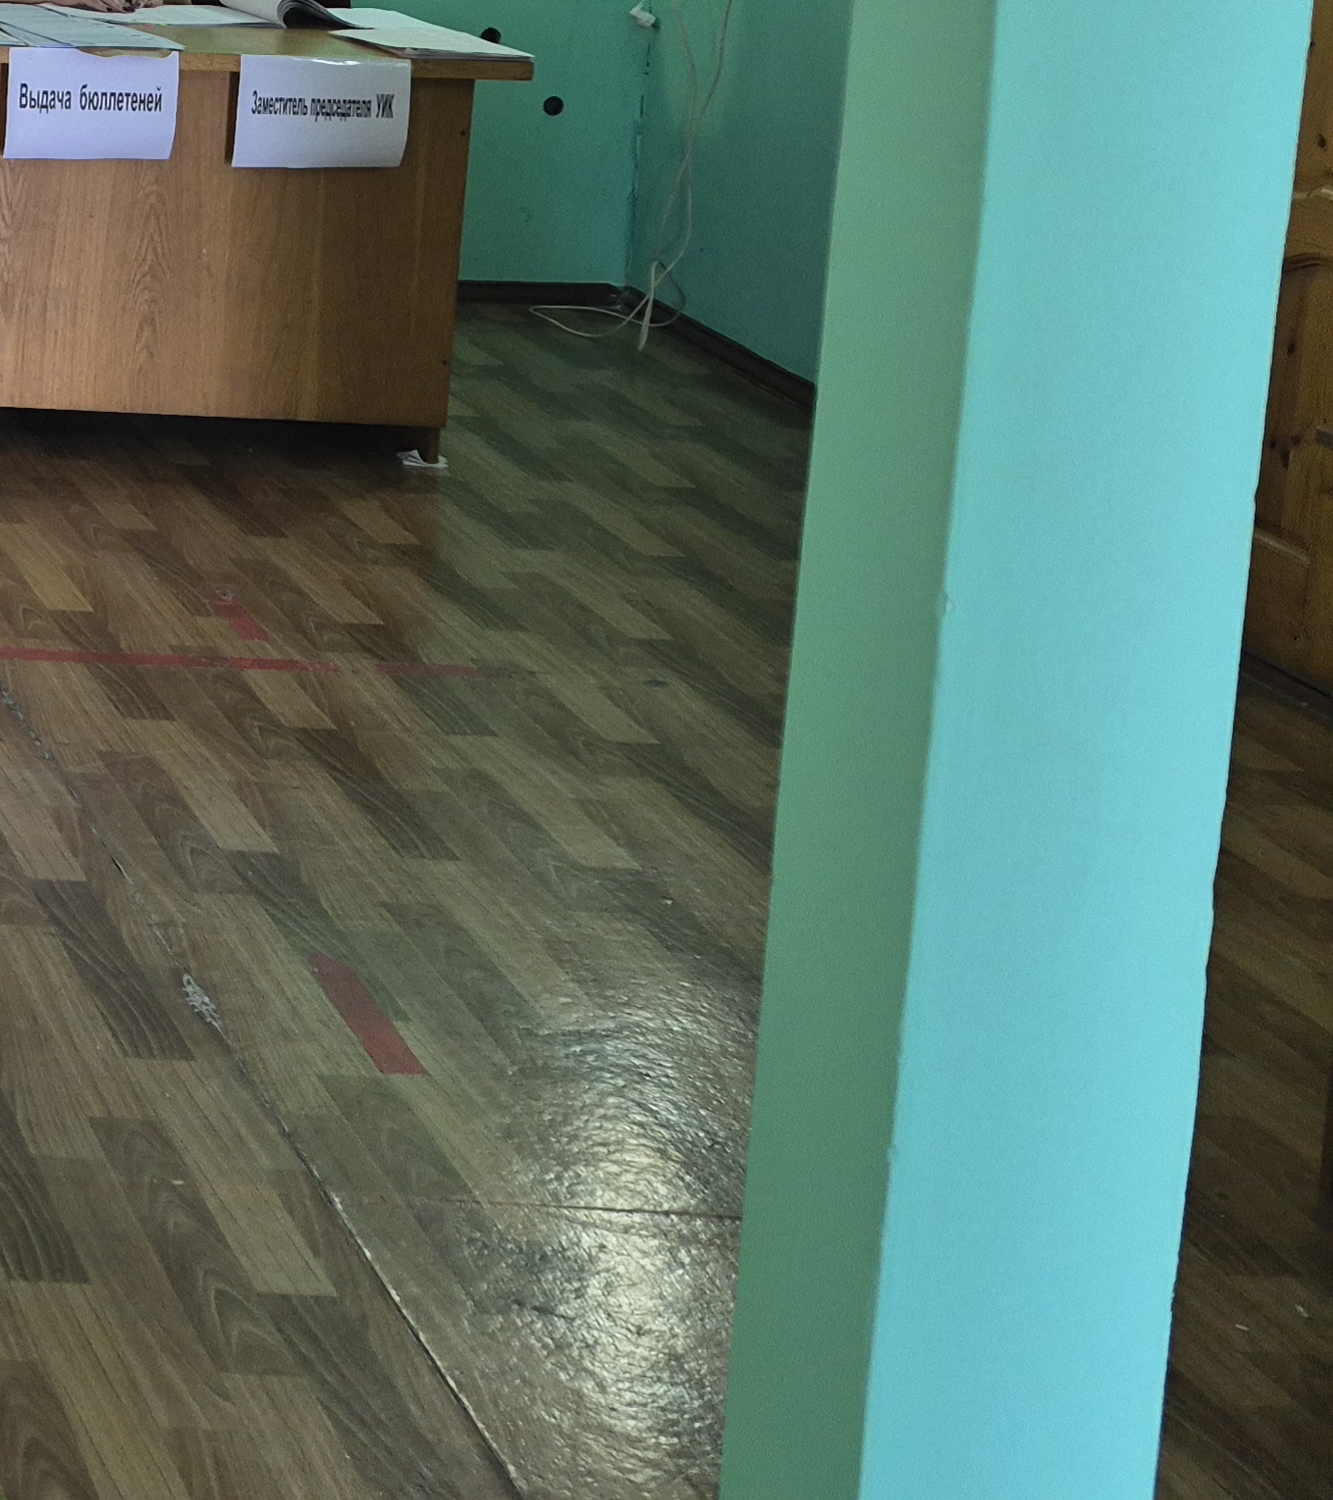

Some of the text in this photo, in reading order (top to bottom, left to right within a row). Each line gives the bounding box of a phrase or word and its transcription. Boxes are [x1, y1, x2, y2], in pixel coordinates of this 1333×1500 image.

[19, 83, 163, 114] Выдача бюллетеней
[251, 90, 395, 122] Заместитель председателя УИК
